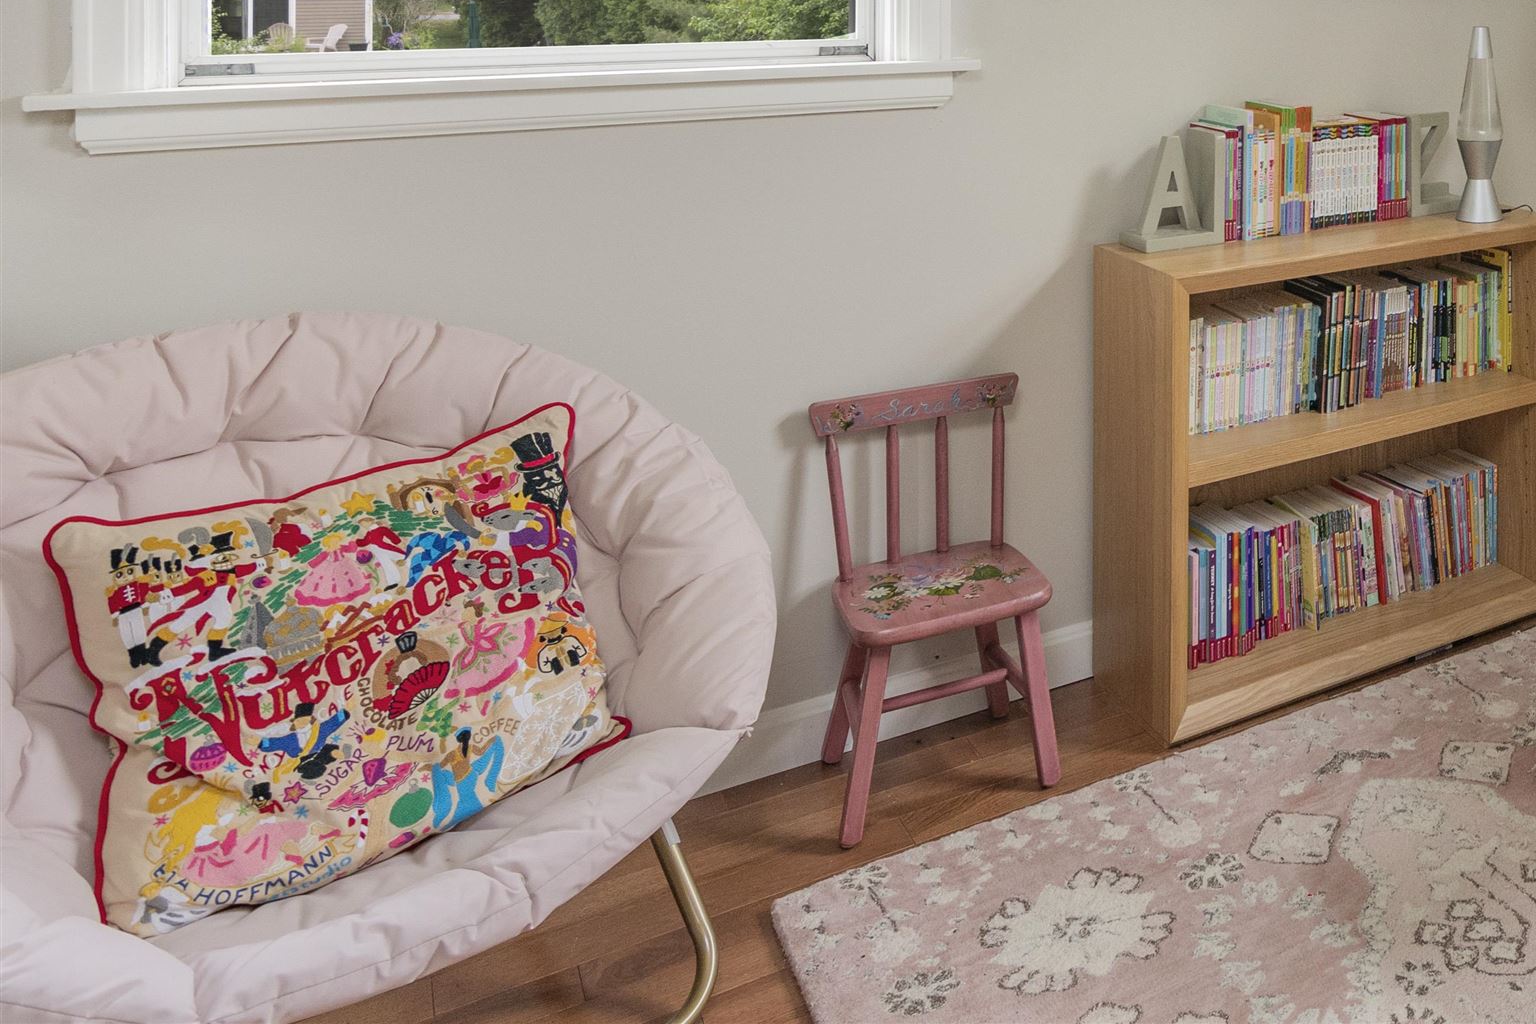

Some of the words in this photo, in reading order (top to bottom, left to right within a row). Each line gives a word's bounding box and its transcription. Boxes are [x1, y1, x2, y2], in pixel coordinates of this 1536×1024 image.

[872, 384, 962, 421] Sarah
[357, 677, 418, 731] CHOCOLATE
[472, 718, 521, 744] COFFEE
[315, 748, 370, 797] SUGAR
[385, 732, 435, 753] PLUM
[193, 845, 333, 906] HOFFMANN
